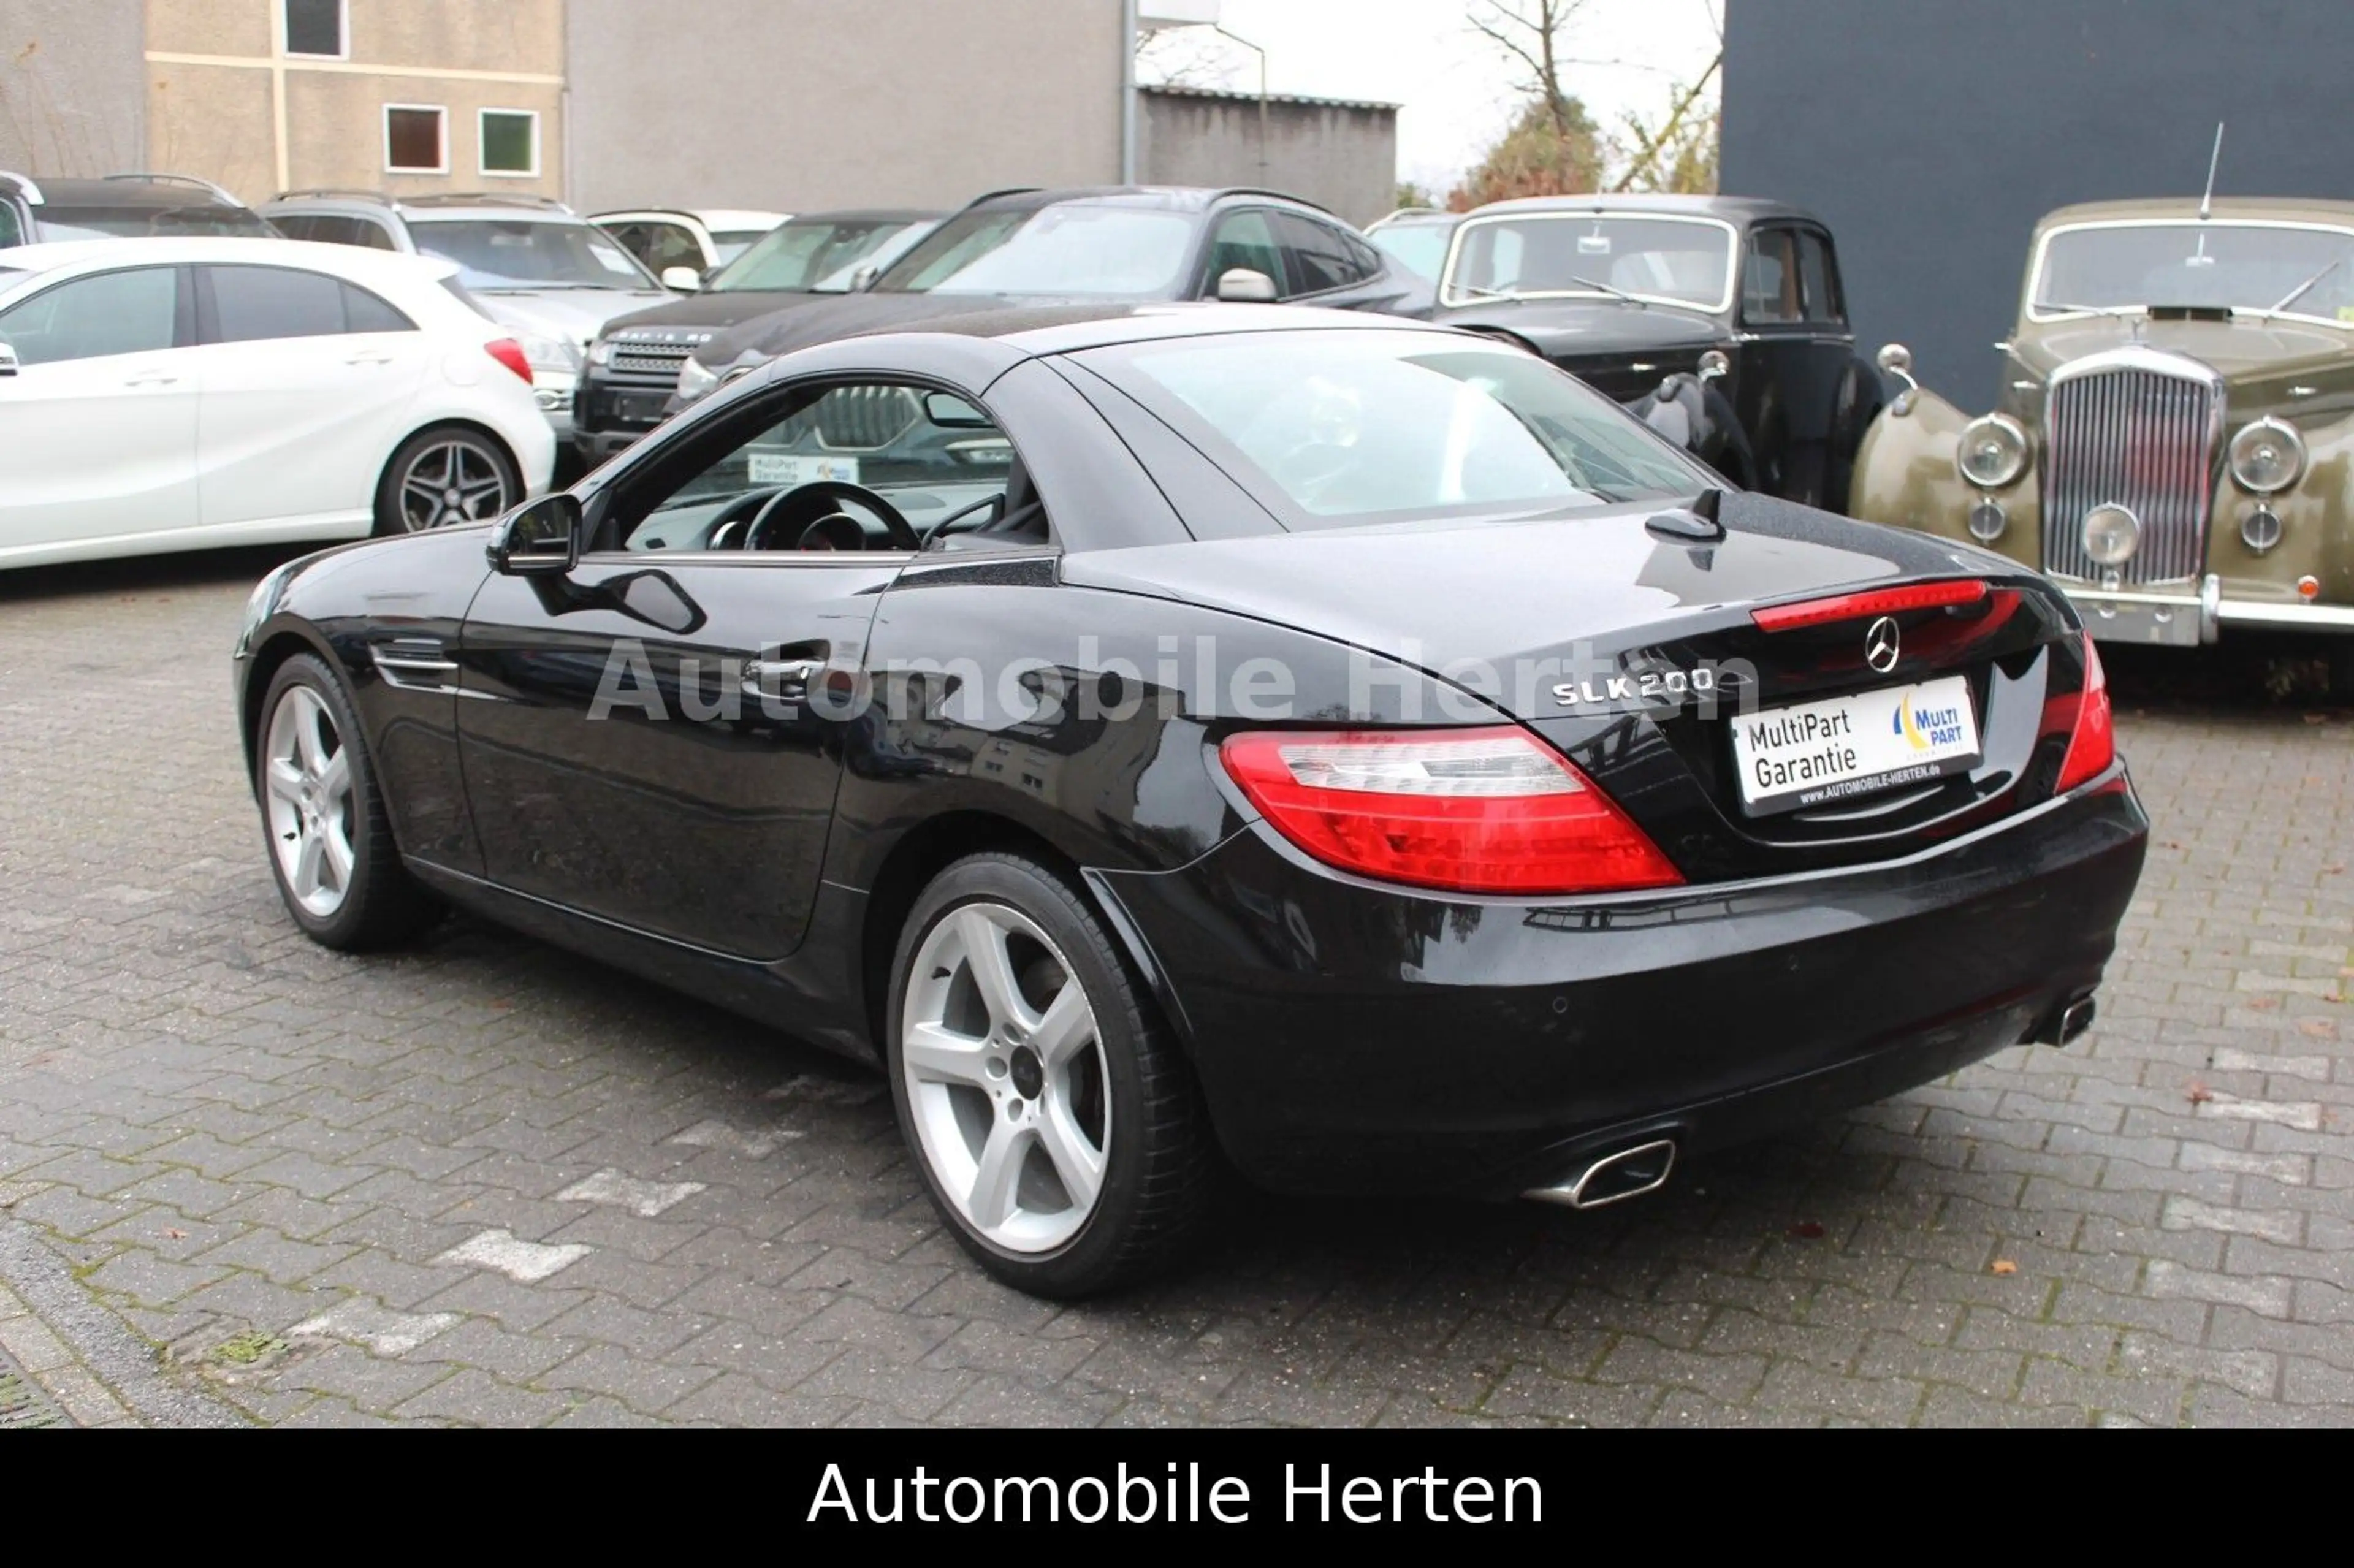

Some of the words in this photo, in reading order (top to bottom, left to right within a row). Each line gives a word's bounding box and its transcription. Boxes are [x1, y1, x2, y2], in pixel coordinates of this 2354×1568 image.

[1553, 677, 1632, 706] SLK
[1640, 669, 1713, 697] 200
[1748, 709, 1851, 752] MultiPart
[1915, 707, 1959, 730] MULTI
[1930, 726, 1962, 746] PART
[1755, 743, 1857, 788] Garantie
